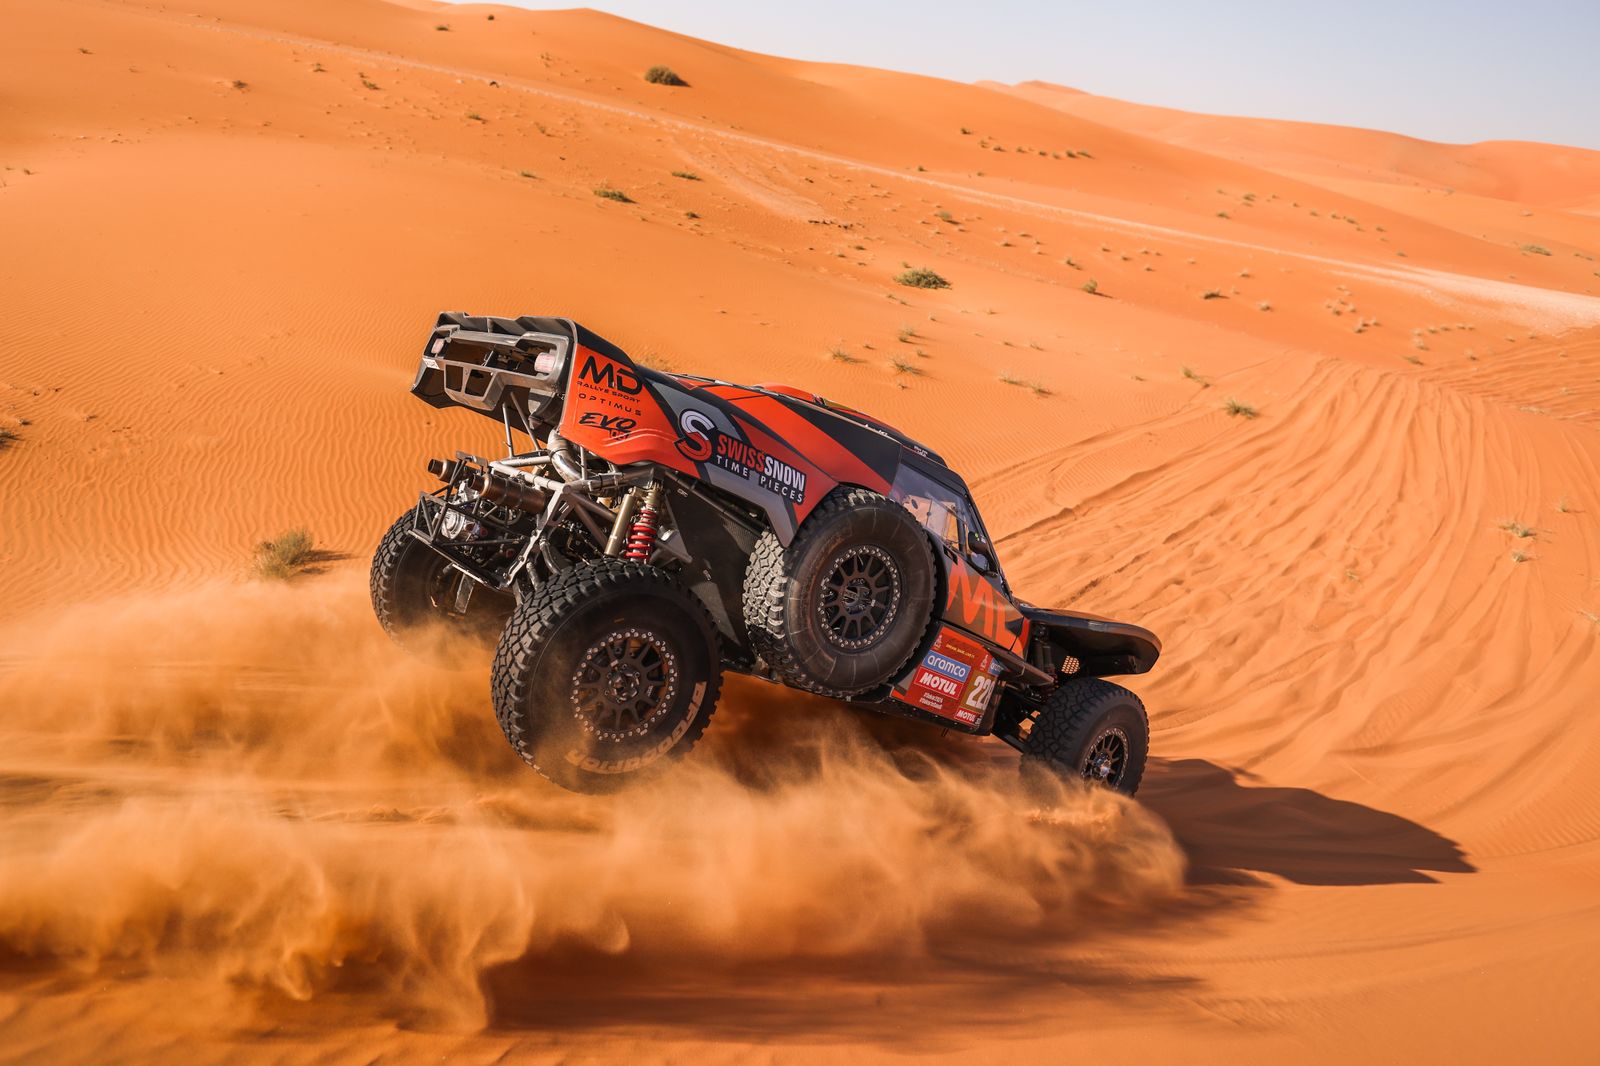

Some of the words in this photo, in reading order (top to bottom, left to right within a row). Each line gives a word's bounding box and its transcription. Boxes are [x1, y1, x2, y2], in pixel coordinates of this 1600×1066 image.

[578, 355, 643, 395] MD
[577, 380, 608, 394] RALLYE
[611, 390, 641, 404] SPORT
[578, 392, 642, 417] OPTIMUS
[578, 411, 638, 430] EVO
[716, 454, 749, 477] TIME
[760, 475, 804, 503] PIECES
[927, 655, 966, 678] aramco
[919, 671, 959, 696] MOTUL
[956, 709, 976, 723] MOTUL
